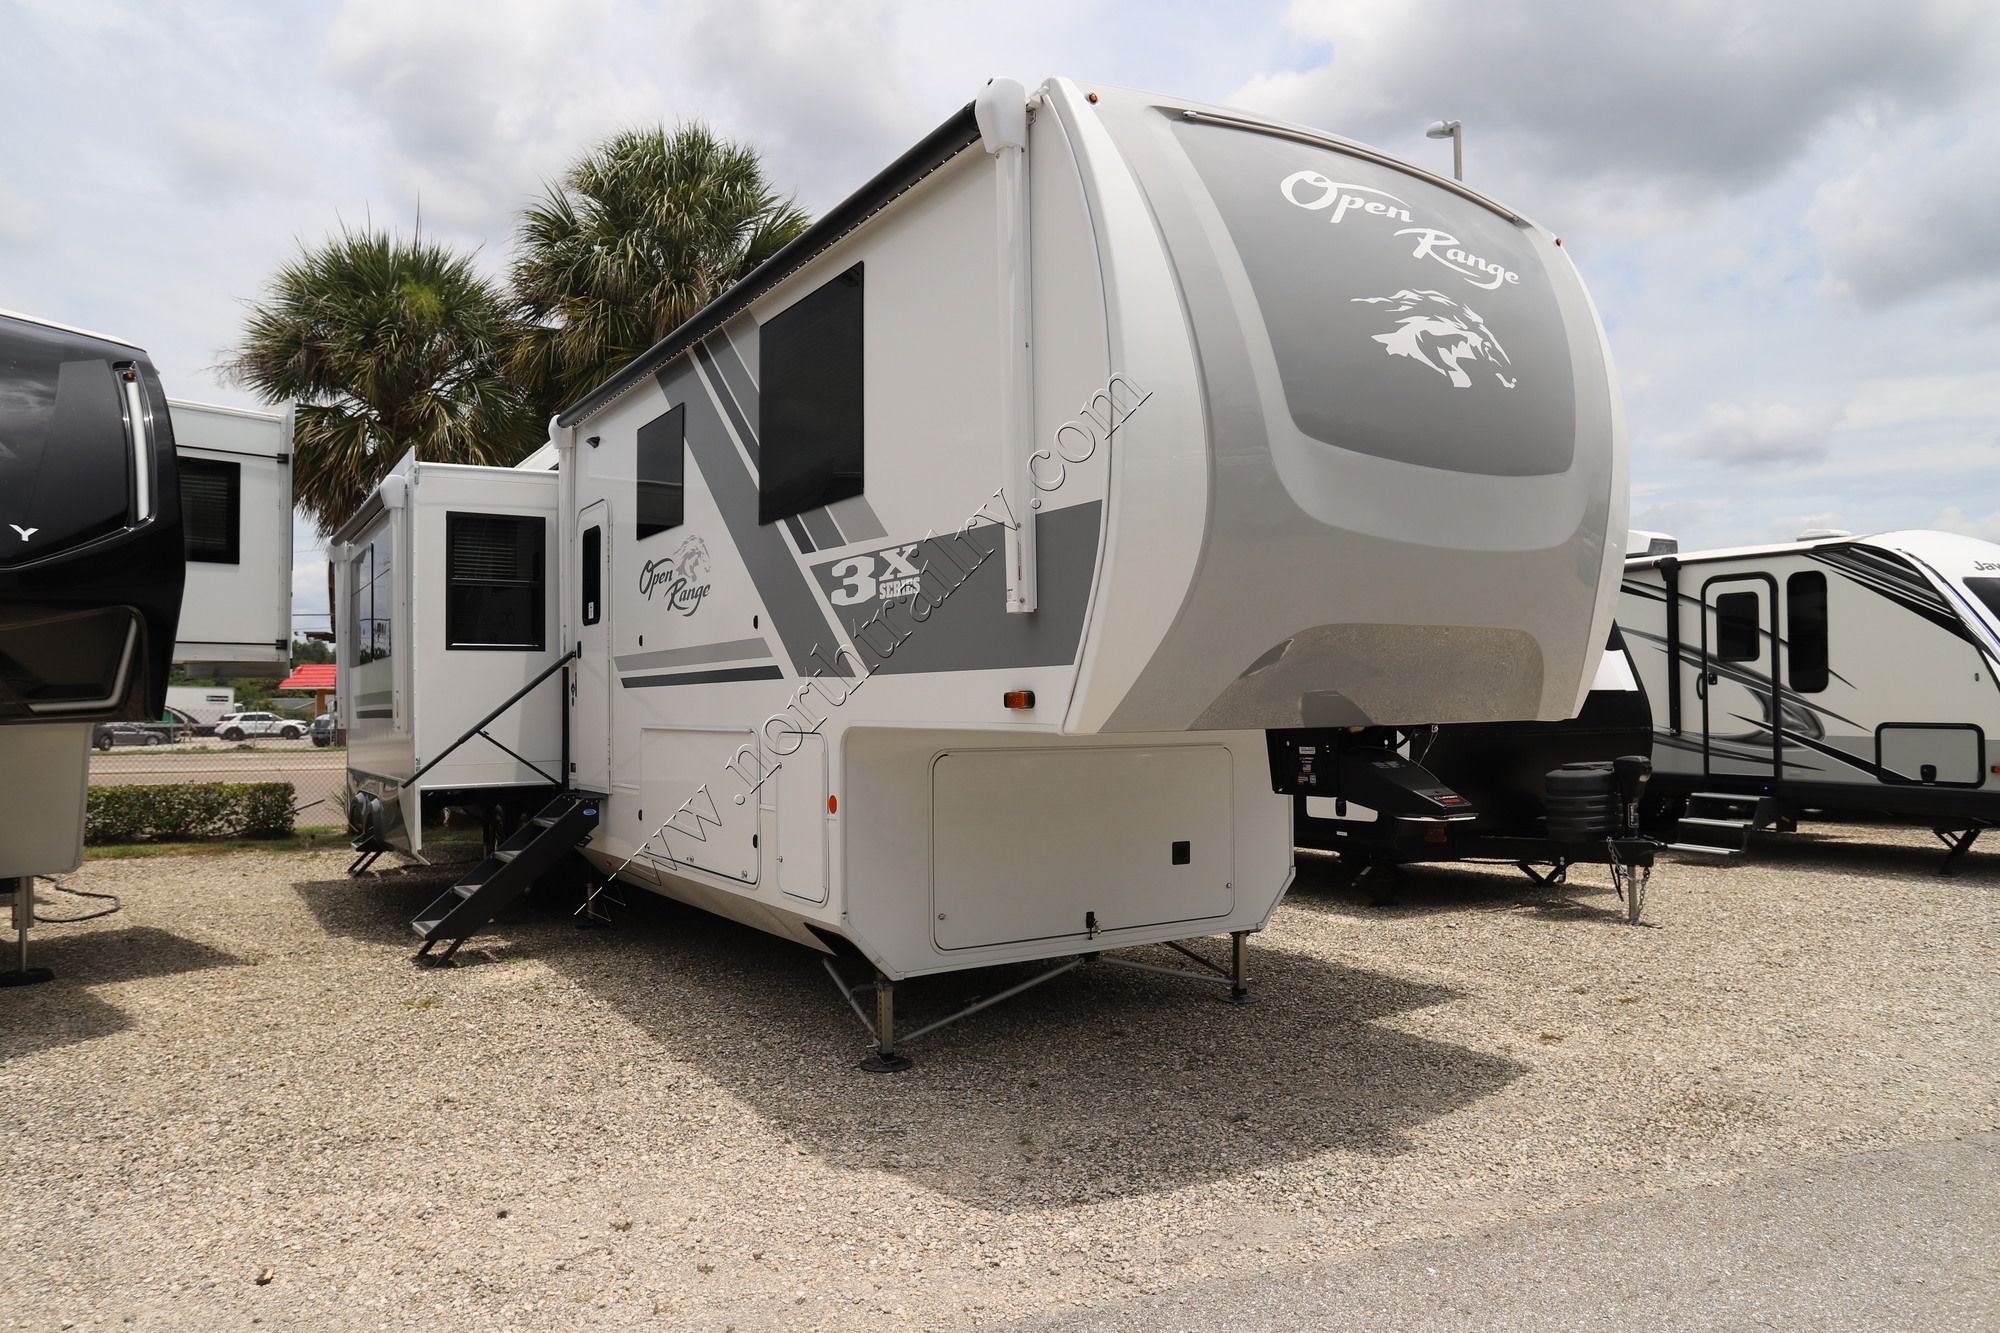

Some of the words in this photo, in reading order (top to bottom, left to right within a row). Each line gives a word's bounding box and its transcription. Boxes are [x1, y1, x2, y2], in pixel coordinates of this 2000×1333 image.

[1280, 170, 1414, 224] Open
[1393, 228, 1521, 290] Range
[639, 557, 675, 602] Open
[663, 577, 711, 618] Range
[879, 576, 921, 600] SERIES
